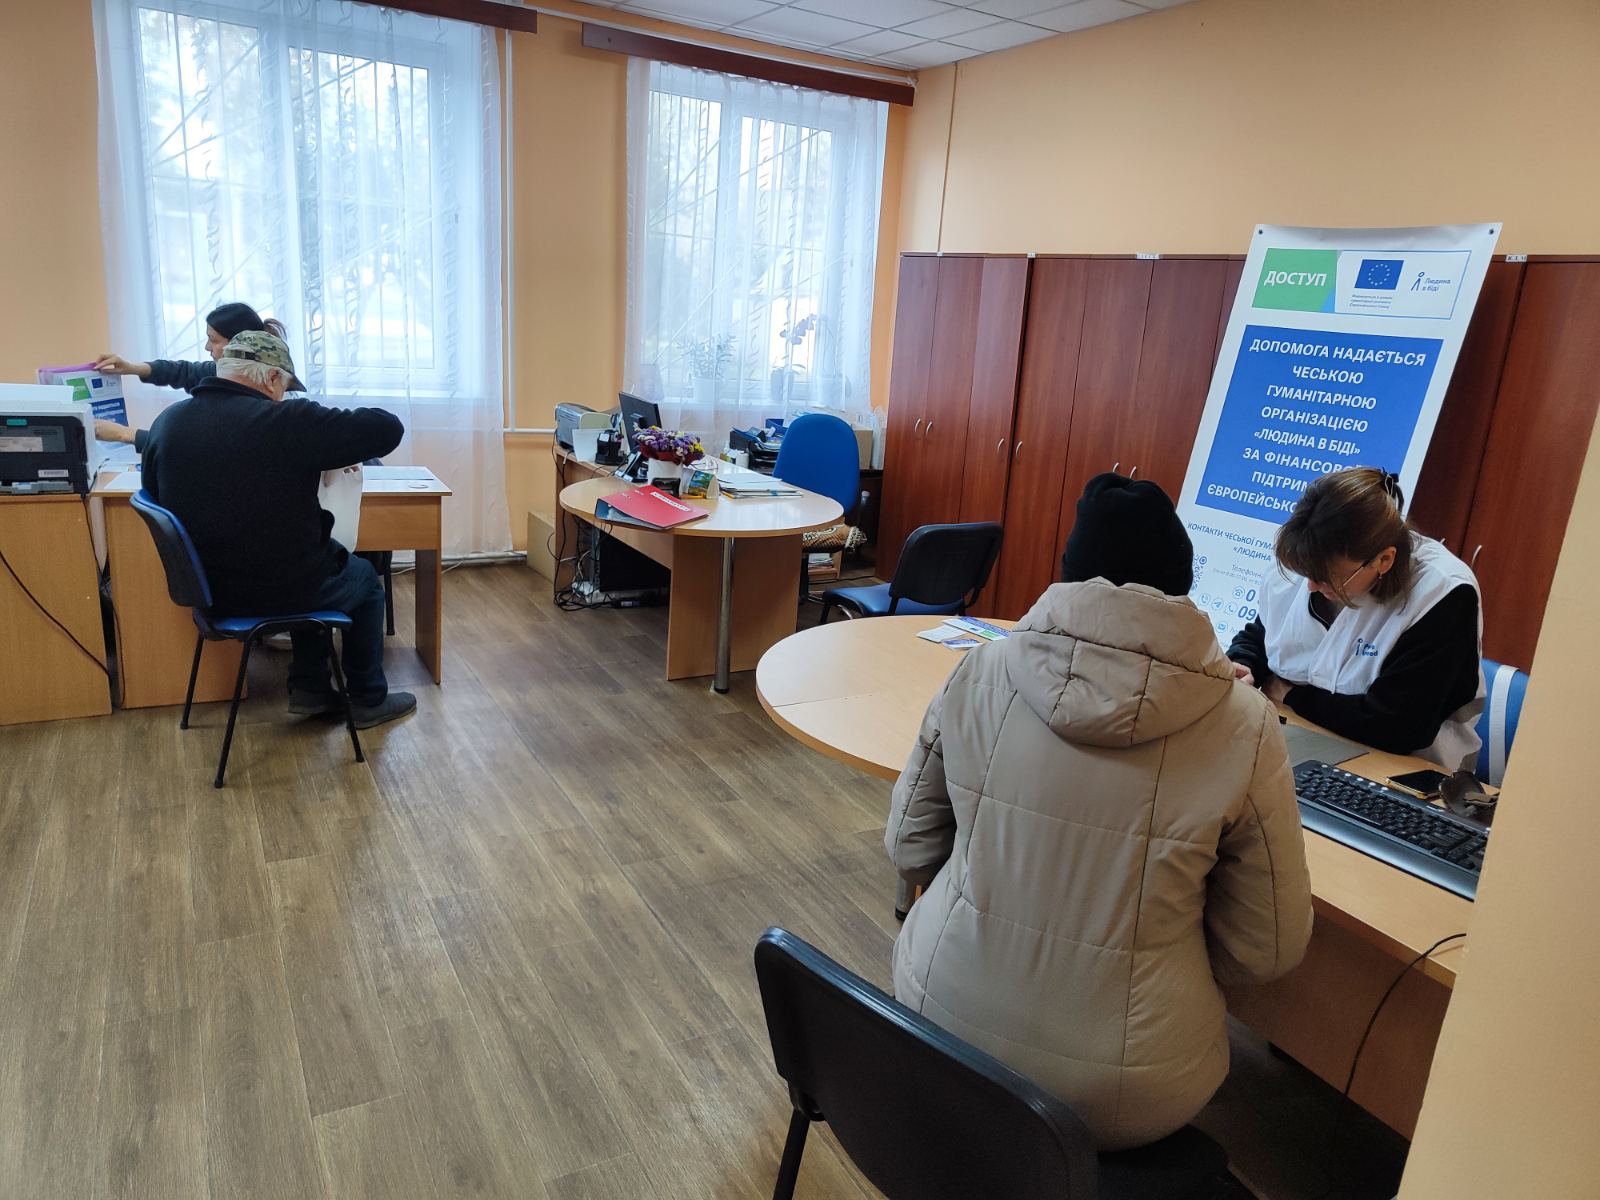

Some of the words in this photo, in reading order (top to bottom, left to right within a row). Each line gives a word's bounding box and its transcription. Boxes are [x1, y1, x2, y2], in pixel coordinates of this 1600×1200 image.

[1263, 269, 1327, 288] ДОСТУП
[1249, 339, 1330, 358] ДОПОМОГА
[1333, 346, 1426, 367] НАДАЄТЬСЯ
[1292, 365, 1364, 384] ЧЕСЬКОЮ
[1266, 384, 1377, 410] ГУМАНІТАРНОЮ
[1261, 406, 1368, 433] ОРГАНІЗАЦІЄЮ
[1254, 428, 1315, 448] «ЛЮДИНА
[1317, 438, 1326, 450] В
[1328, 440, 1361, 457] БІДІ»
[1242, 447, 1260, 460] ЗА
[1264, 451, 1362, 474] ФІНАНСОВ
[1207, 484, 1298, 513] ЄВРОПЕЙСЬКО
[1187, 522, 1223, 537] КОНТАКТИ
[1224, 531, 1254, 545] ЧЕСЬКОЇ
[1233, 546, 1271, 562] «ЛЮДИНА
[1245, 589, 1256, 602] 0
[1237, 605, 1257, 621] 09
